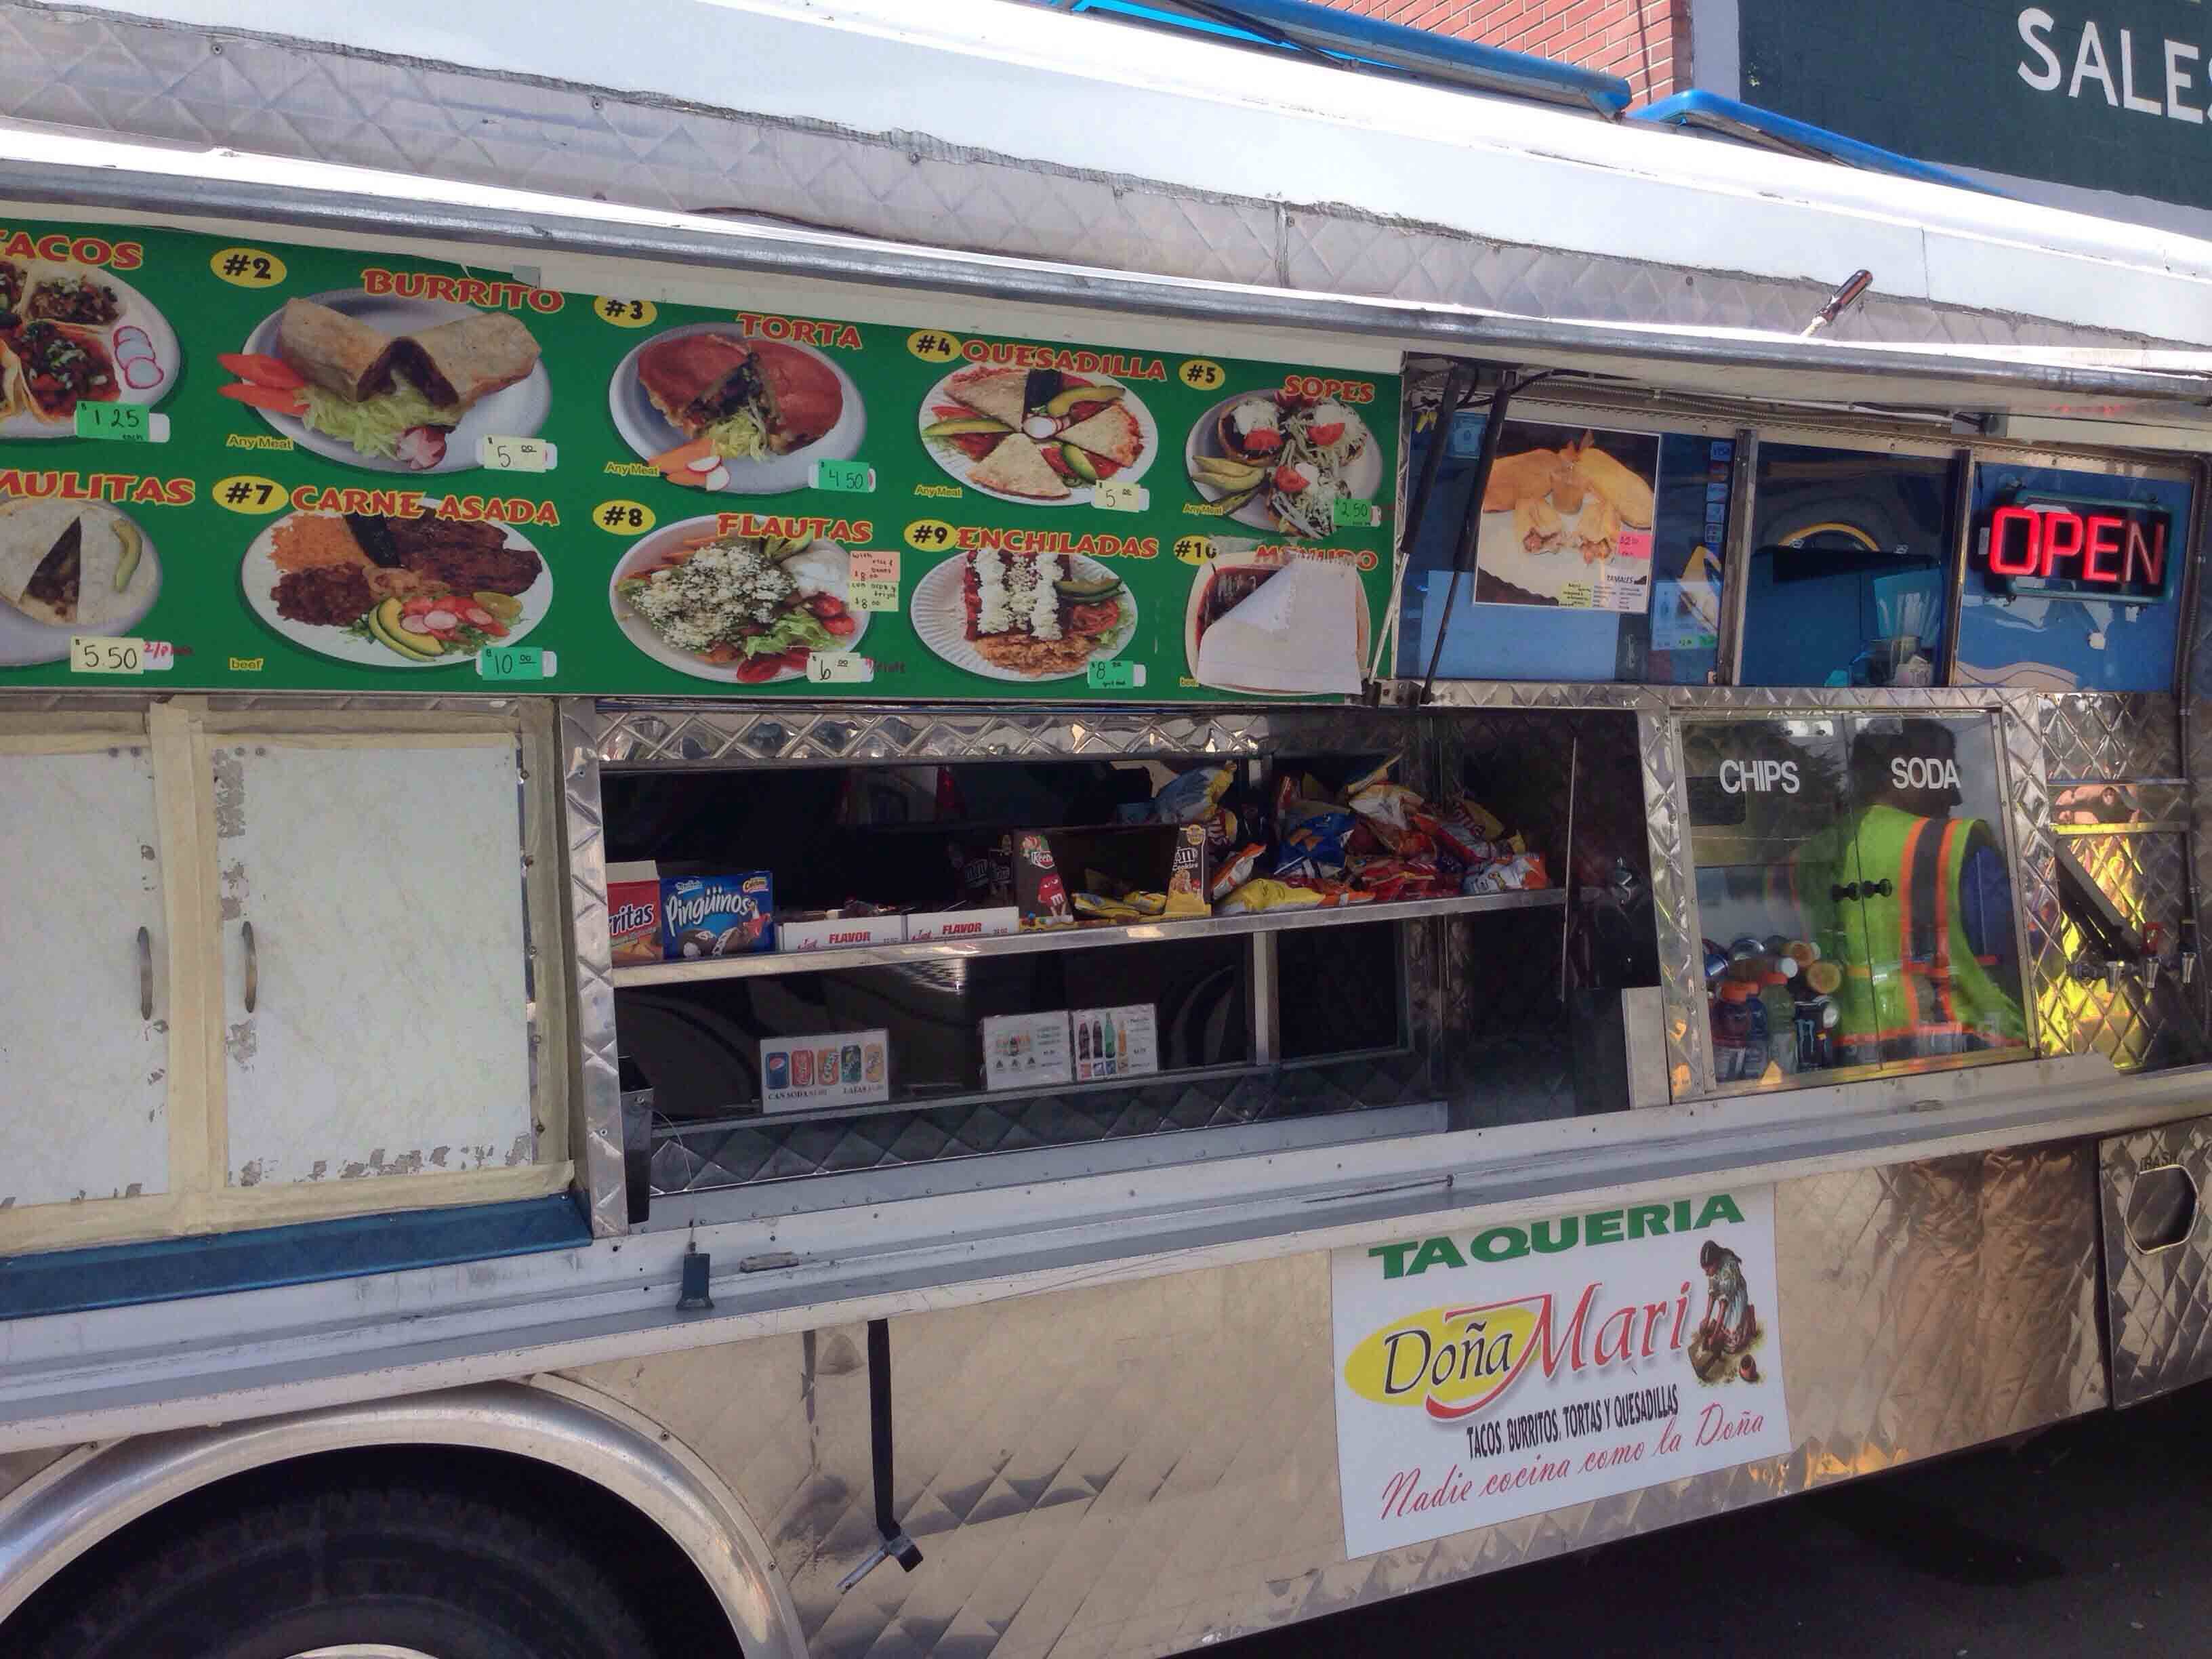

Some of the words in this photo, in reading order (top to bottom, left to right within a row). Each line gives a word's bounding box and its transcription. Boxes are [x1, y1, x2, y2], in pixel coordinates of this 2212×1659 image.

[2017, 7, 2212, 124] SALE
[0, 229, 144, 270] ACOS
[223, 254, 271, 279] #2
[363, 268, 565, 313] BURRITO
[605, 300, 643, 320] #3
[736, 312, 863, 350] TORTA
[916, 334, 951, 356] #4
[960, 339, 1168, 382] QUESADILLA
[1187, 365, 1216, 384] #5
[1283, 374, 1375, 405] SOPES
[227, 434, 256, 450] Any
[257, 436, 293, 451] Meat
[631, 463, 660, 476] Meat
[225, 482, 274, 504] #7
[291, 485, 426, 518] CARNE
[435, 495, 560, 528] ASADA
[603, 506, 643, 527] #8
[716, 512, 874, 544] FLAUTAS
[913, 525, 948, 545] #9
[955, 527, 1160, 559] ENCHILADAS
[1989, 506, 2166, 586] OPEN
[228, 657, 264, 671] beef
[1719, 758, 1801, 794] CHIPS
[1891, 757, 1962, 791] SODA
[665, 886, 751, 937] Pingüinos
[829, 931, 871, 944] FLAVOR
[942, 922, 982, 935] FLAVOR
[1368, 1193, 1745, 1281] TAQUERIA
[1384, 1320, 1513, 1396] Doña
[1425, 1281, 1692, 1420] Mari
[1562, 1401, 1603, 1439] TORTAS
[1603, 1401, 1612, 1429] Y
[1614, 1383, 1679, 1428] QUESADILLAS
[1379, 1464, 1473, 1520] Nadie
[1479, 1454, 1571, 1497] cocina
[1577, 1441, 1645, 1476] como
[1654, 1416, 1682, 1458] la
[1694, 1401, 1764, 1448] Doña
